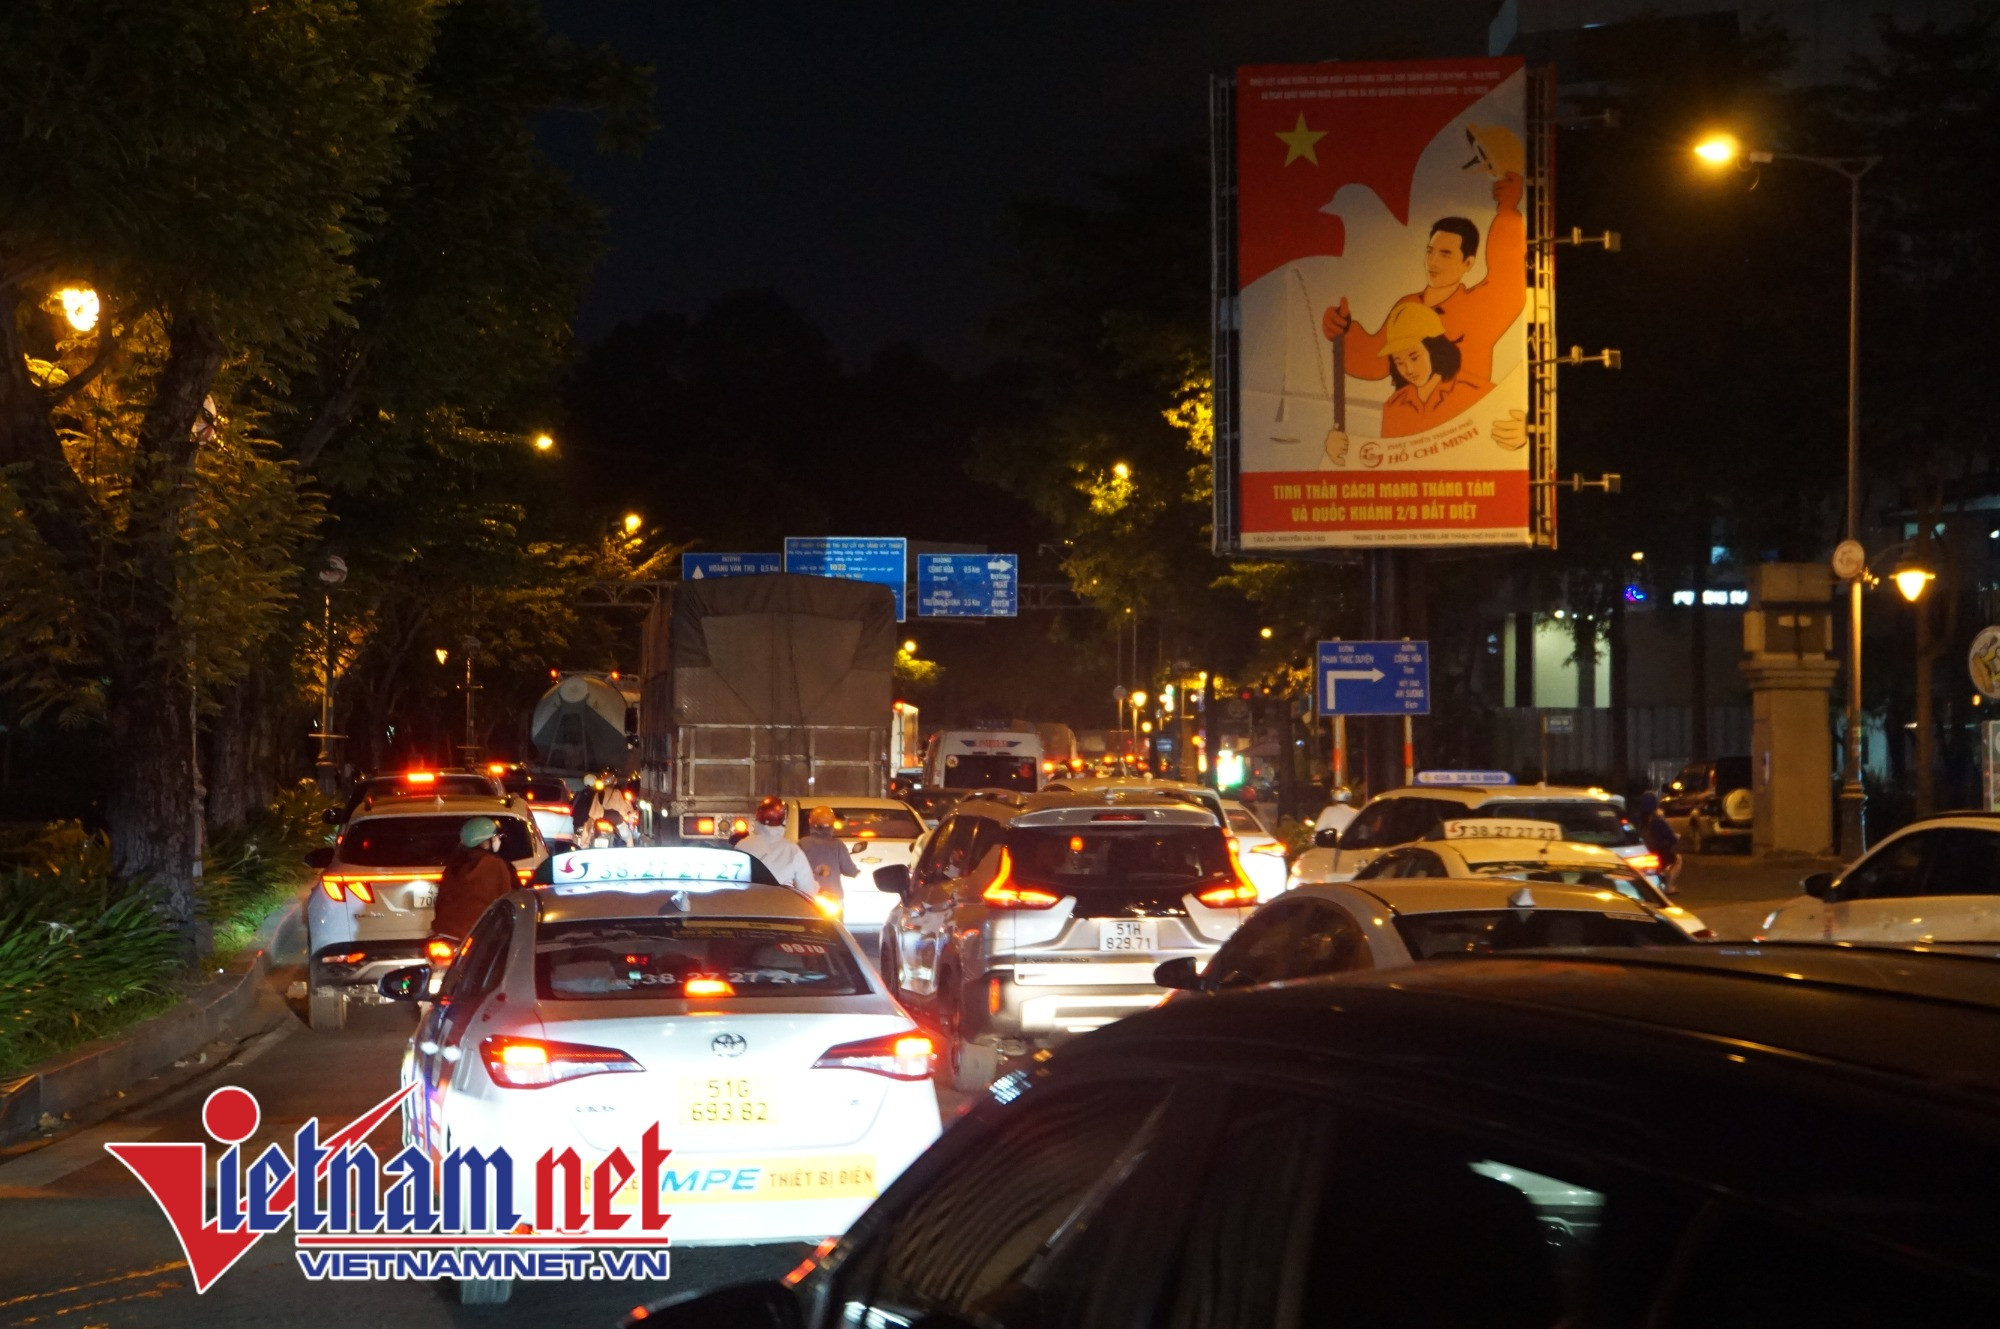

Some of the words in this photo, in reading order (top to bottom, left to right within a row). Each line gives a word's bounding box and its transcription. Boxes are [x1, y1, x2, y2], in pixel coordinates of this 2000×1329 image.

[1388, 448, 1409, 464] HỒ
[1413, 442, 1439, 459] CHÍ
[1441, 427, 1479, 452] MINH
[1273, 484, 1302, 500] TINH
[1305, 479, 1338, 500] THẦN
[1341, 481, 1375, 499] CÁCH
[1380, 483, 1418, 501] MẠNG
[1422, 480, 1463, 498] THÁNG
[1466, 479, 1496, 497] TÁM
[1291, 503, 1309, 522] VÀ
[1312, 501, 1346, 522] QUỐC
[1349, 503, 1393, 521] KHÁNH
[1396, 505, 1418, 522] 2/9
[1421, 499, 1446, 520] BẤT
[1449, 501, 1478, 522] DIỆT
[1516, 826, 1534, 839] 27
[678, 862, 704, 880] 27
[716, 862, 744, 880] 27
[1116, 923, 1141, 936] 51H
[1106, 937, 1151, 950] 829.71
[728, 972, 759, 984] 27
[708, 1079, 748, 1098] 51G
[661, 1167, 761, 1192] MPE
[769, 1169, 813, 1189] THIẾT
[819, 1170, 834, 1189] BỊ
[840, 1165, 874, 1186] ĐIỆN
